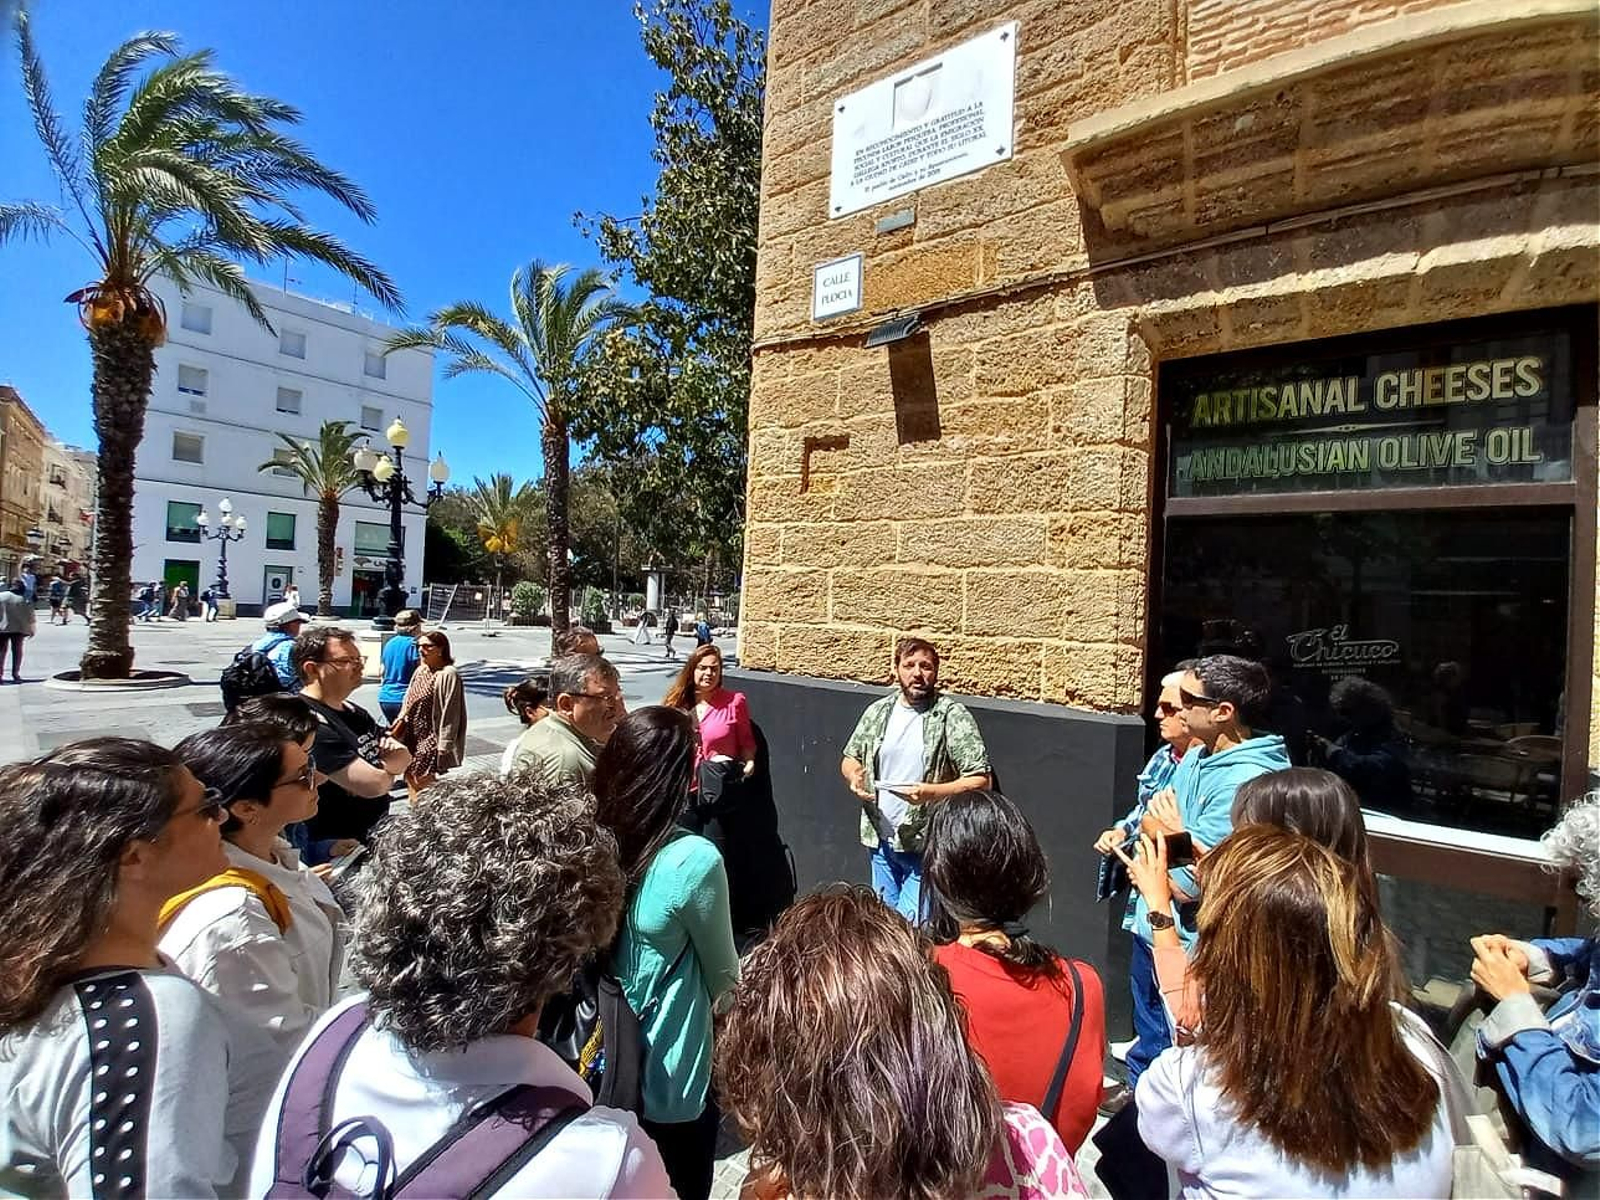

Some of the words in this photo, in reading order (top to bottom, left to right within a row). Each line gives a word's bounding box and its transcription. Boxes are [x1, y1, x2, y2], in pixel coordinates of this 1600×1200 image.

[865, 124, 922, 152] RECONOCIMIENTO
[930, 107, 964, 126] GRATITUD
[882, 140, 901, 153] LABOR
[882, 144, 912, 160] CULTURAL
[823, 271, 851, 288] CALLE
[1191, 376, 1367, 426] ARTISANAL
[1375, 355, 1543, 412] CHEESES
[1188, 438, 1371, 482] ANDALUSIAN
[1377, 430, 1477, 473] OLIVE
[1485, 426, 1544, 465] OIL
[1285, 628, 1400, 662] Chicuco
[1329, 624, 1349, 641] El
